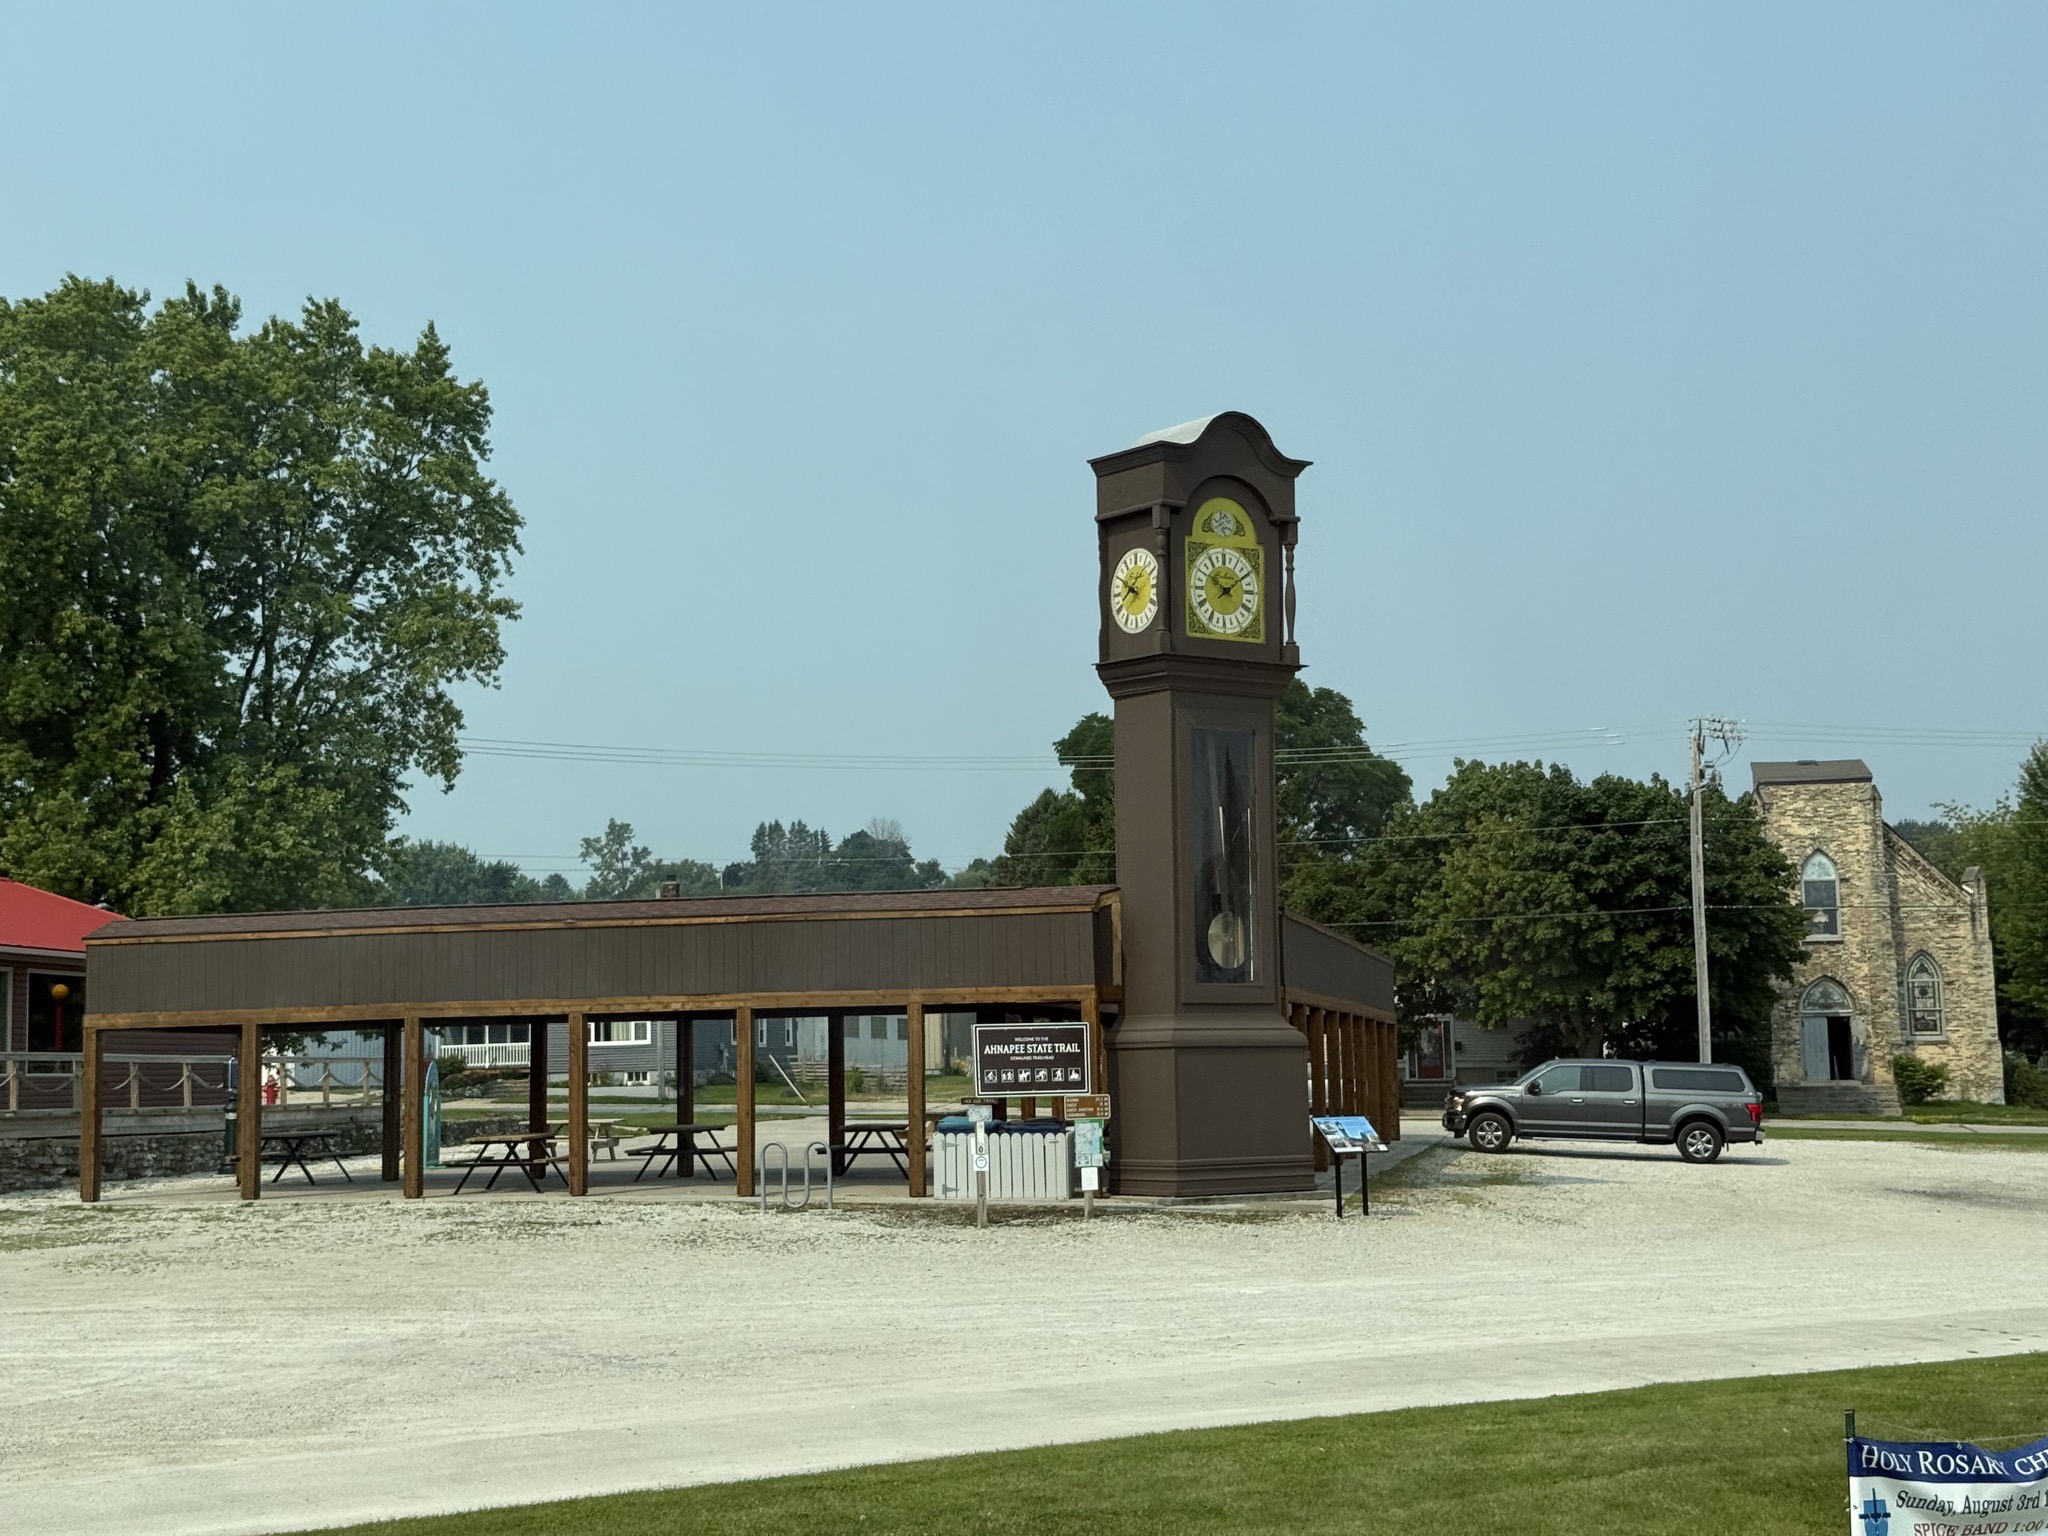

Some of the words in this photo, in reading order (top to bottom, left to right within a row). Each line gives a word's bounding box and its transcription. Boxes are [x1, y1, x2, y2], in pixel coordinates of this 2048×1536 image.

[984, 1044, 1025, 1054] AHNAPEE
[1026, 1043, 1053, 1053] STATE
[1055, 1043, 1080, 1053] TRAIL
[1861, 1445, 1913, 1473] HOLY
[1896, 1490, 1957, 1517] Sunday,
[1961, 1494, 2013, 1518] August
[2016, 1491, 2040, 1511] 3rd
[1913, 1522, 1958, 1536] SPICE
[1961, 1521, 2008, 1536] BAND
[2012, 1519, 2044, 1533] 1:00
